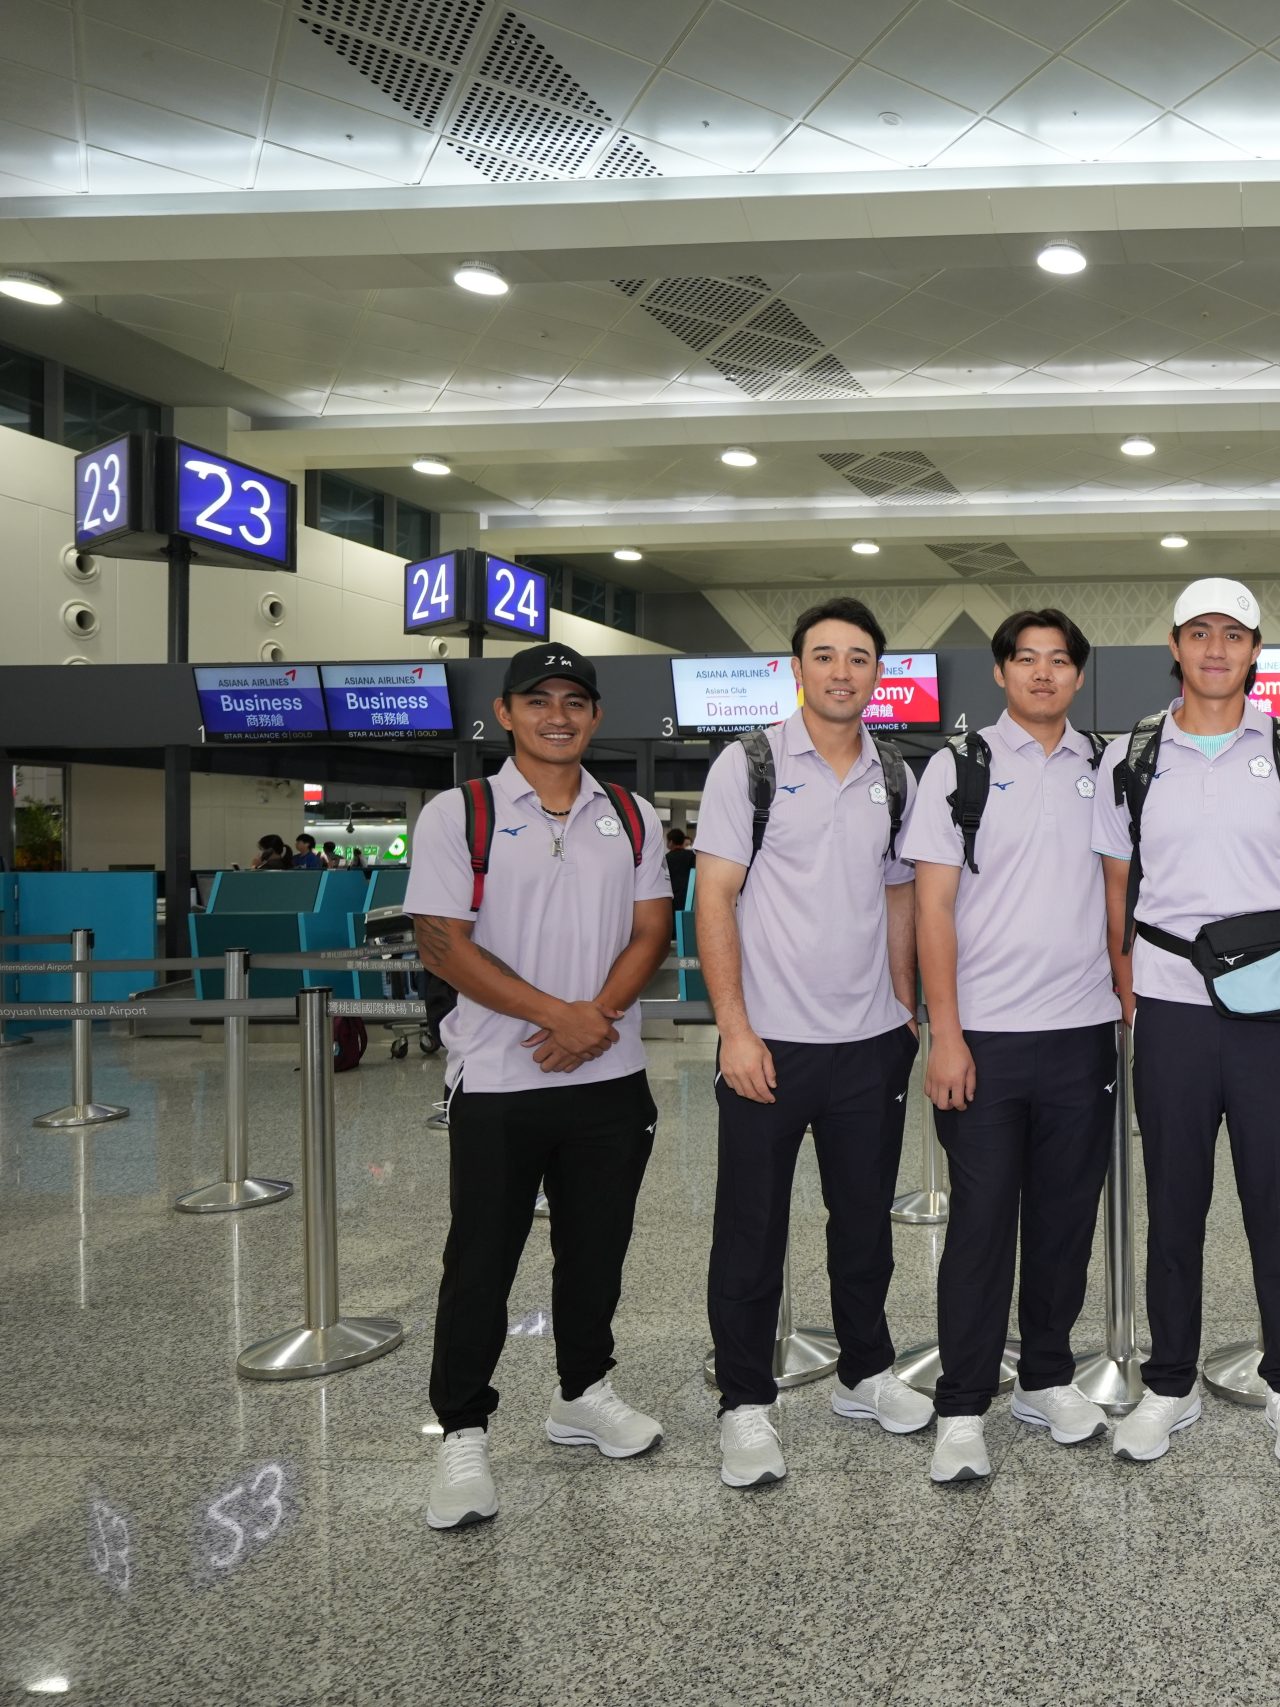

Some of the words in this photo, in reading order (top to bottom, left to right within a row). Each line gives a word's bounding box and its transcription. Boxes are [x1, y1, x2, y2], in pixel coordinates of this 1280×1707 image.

[84, 454, 121, 530] 23
[192, 461, 272, 545] 23
[412, 563, 449, 620] 24
[494, 568, 538, 627] 24
[344, 677, 376, 685] ASIANA
[378, 676, 416, 685] AIRLINES
[696, 670, 728, 679] ASIANA
[730, 669, 770, 678] AIRLINES
[218, 679, 250, 688] ASIANA
[251, 678, 289, 687] AIRLINES
[705, 687, 729, 695] Asiana
[220, 694, 303, 712] Business
[346, 692, 429, 710] Business
[706, 702, 779, 717] Diamond
[246, 713, 285, 727] 商務艙
[371, 712, 410, 726] 商務艙
[954, 713, 969, 731] 4
[198, 725, 206, 743] 1
[368, 730, 405, 738] ALLIANCE
[472, 720, 485, 740] 2
[662, 717, 674, 737] 3
[244, 732, 280, 740] ALLIANCE
[47, 963, 73, 972] Airport
[39, 1006, 106, 1016] International
[109, 1006, 147, 1018] Airport
